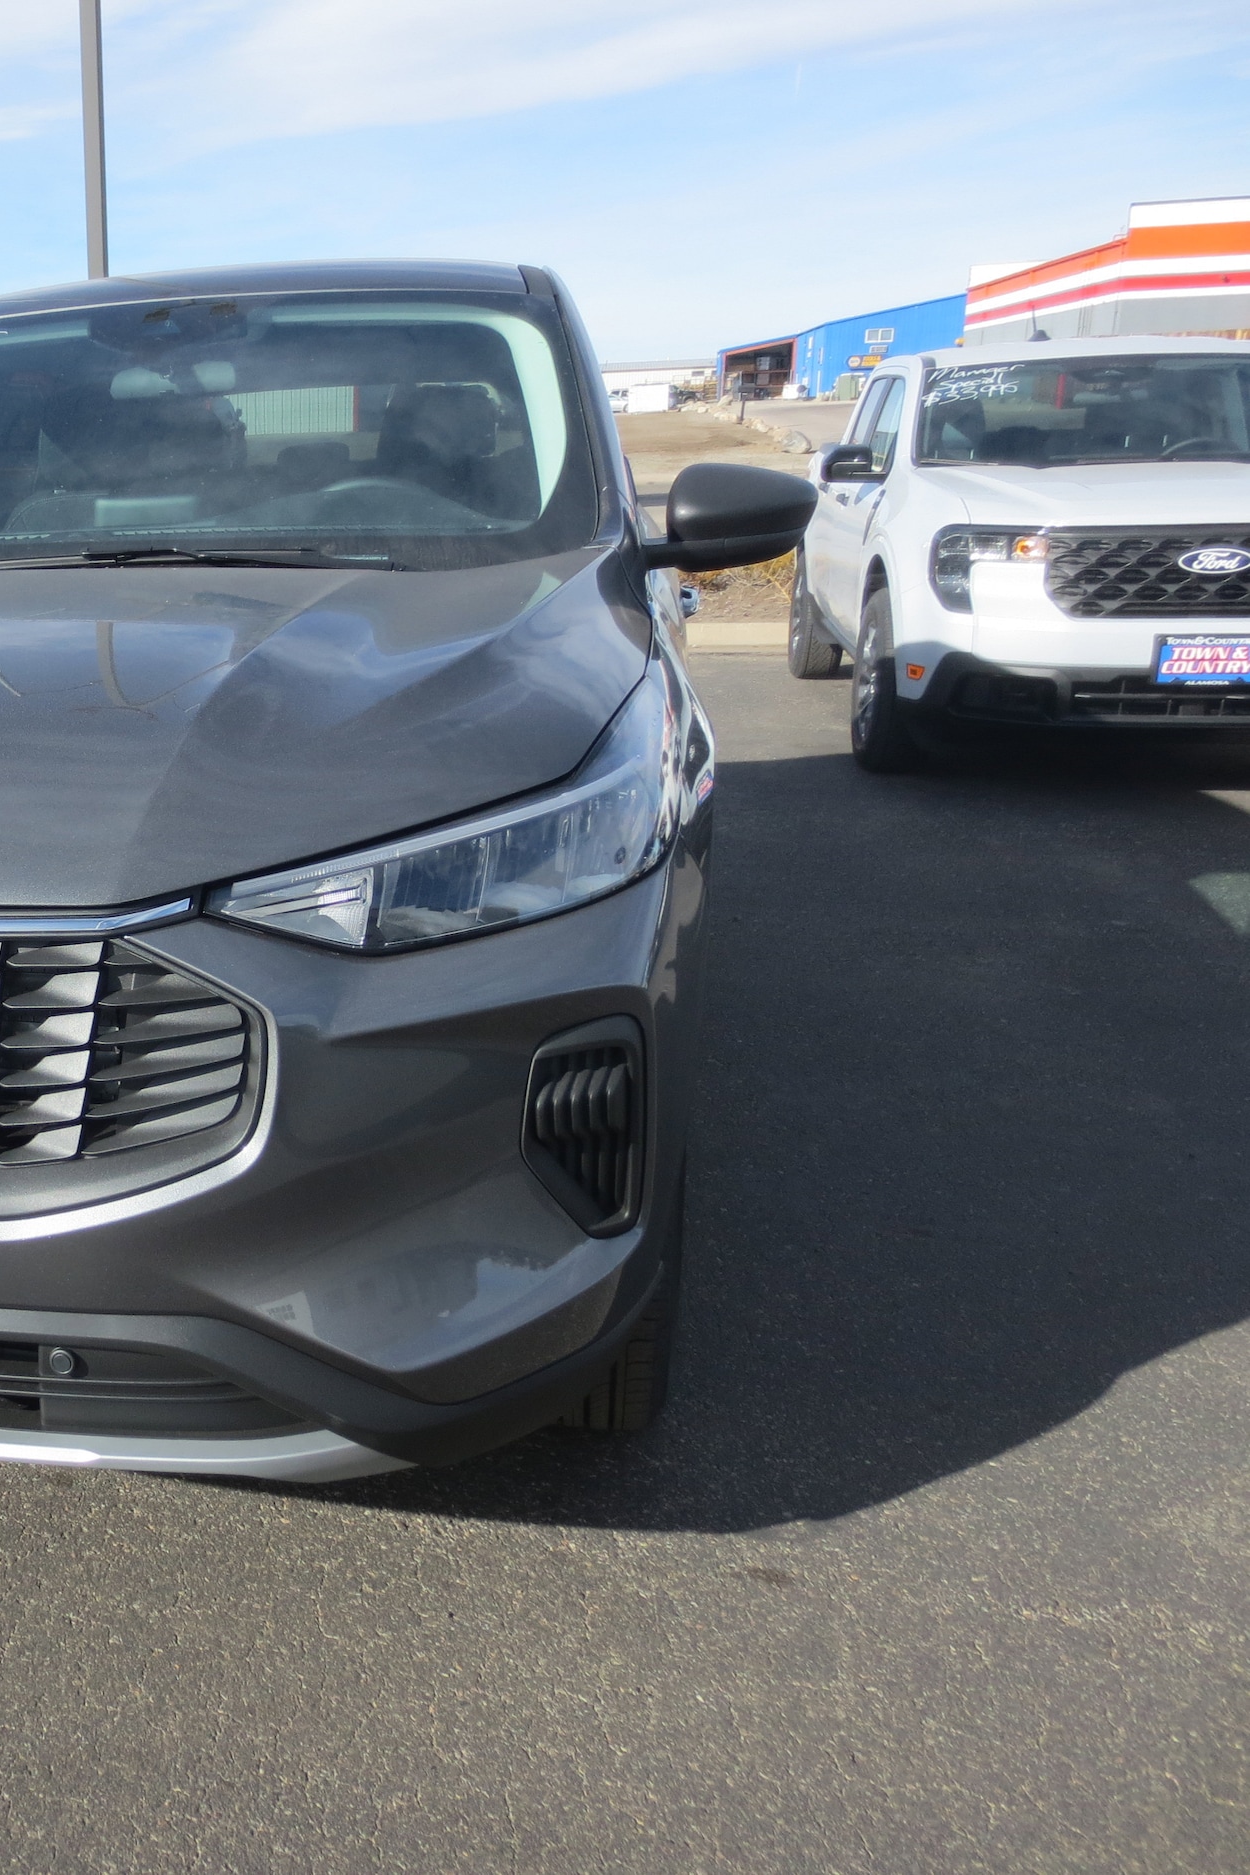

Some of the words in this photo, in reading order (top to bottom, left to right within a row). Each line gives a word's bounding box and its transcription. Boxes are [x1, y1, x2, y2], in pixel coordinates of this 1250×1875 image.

[927, 364, 1026, 383] Manager
[921, 380, 1020, 408] $33,995
[1192, 552, 1242, 569] Ford
[1171, 646, 1231, 660] TOWN
[1231, 646, 1249, 660] &
[1160, 660, 1250, 674] COUNTRY
